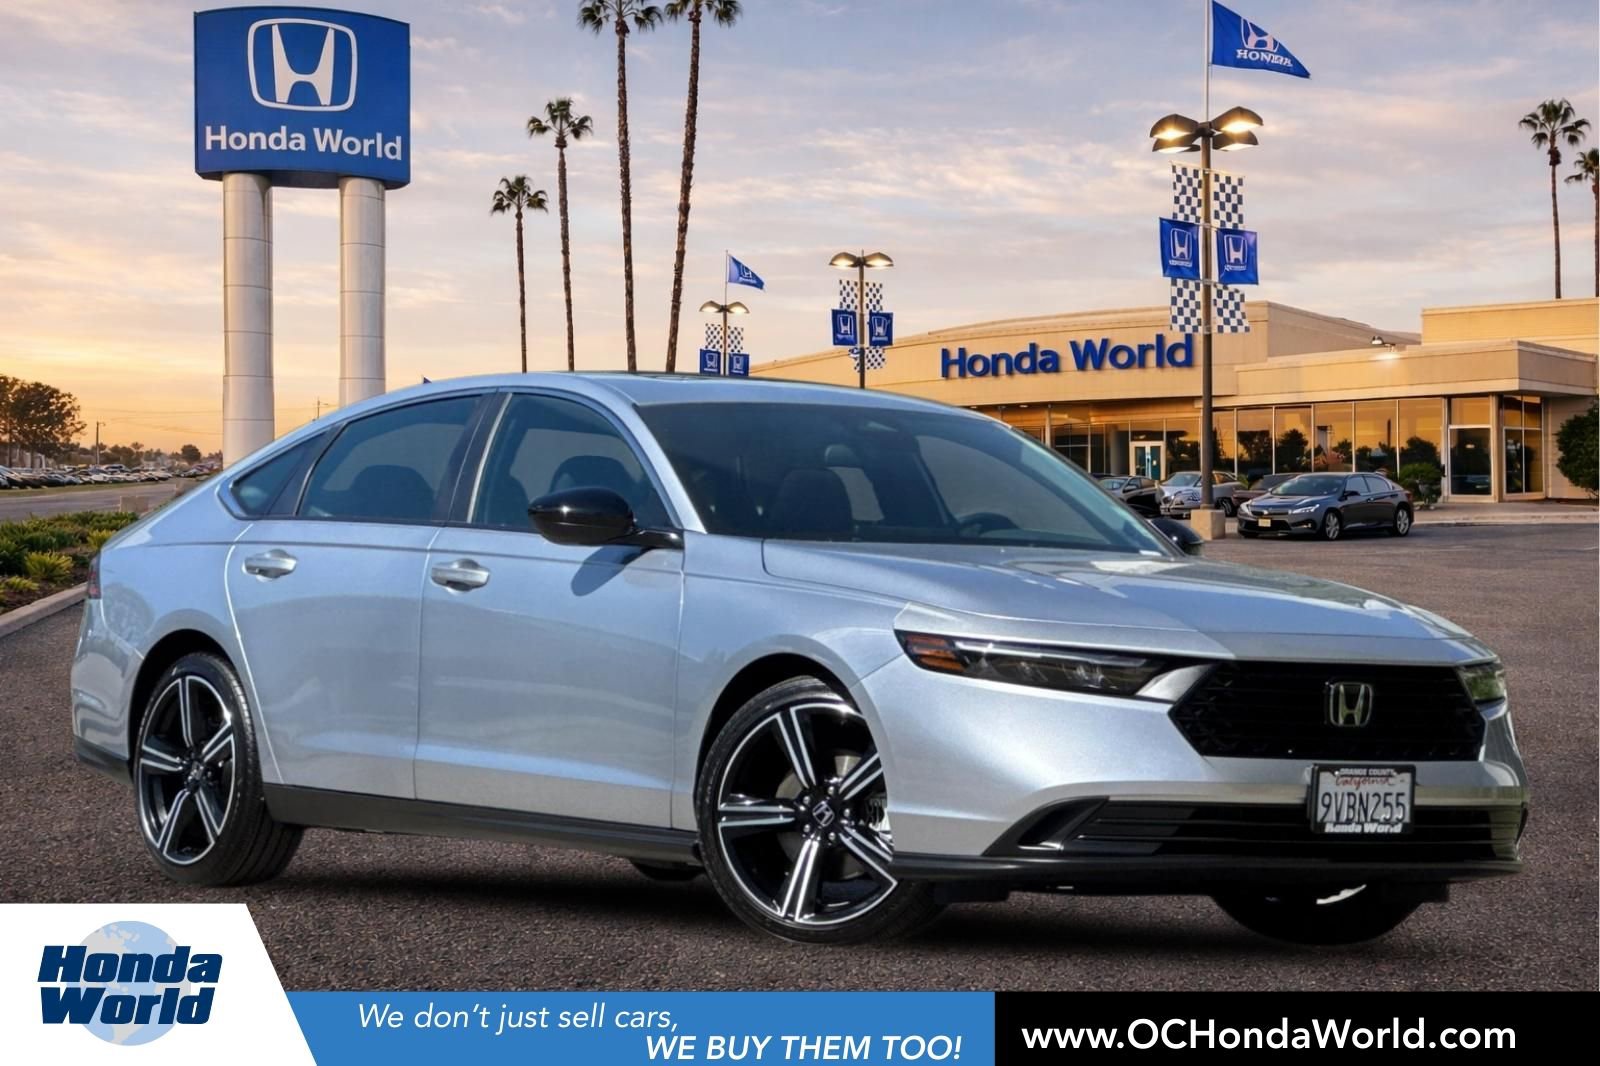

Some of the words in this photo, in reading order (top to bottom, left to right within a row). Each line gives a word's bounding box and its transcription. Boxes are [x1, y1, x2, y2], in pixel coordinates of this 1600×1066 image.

[205, 125, 306, 151] Honda
[313, 127, 402, 160] World
[941, 342, 1062, 378] Honda
[1070, 333, 1194, 371] World
[1336, 776, 1392, 790] California
[1321, 792, 1406, 822] 9VBN255
